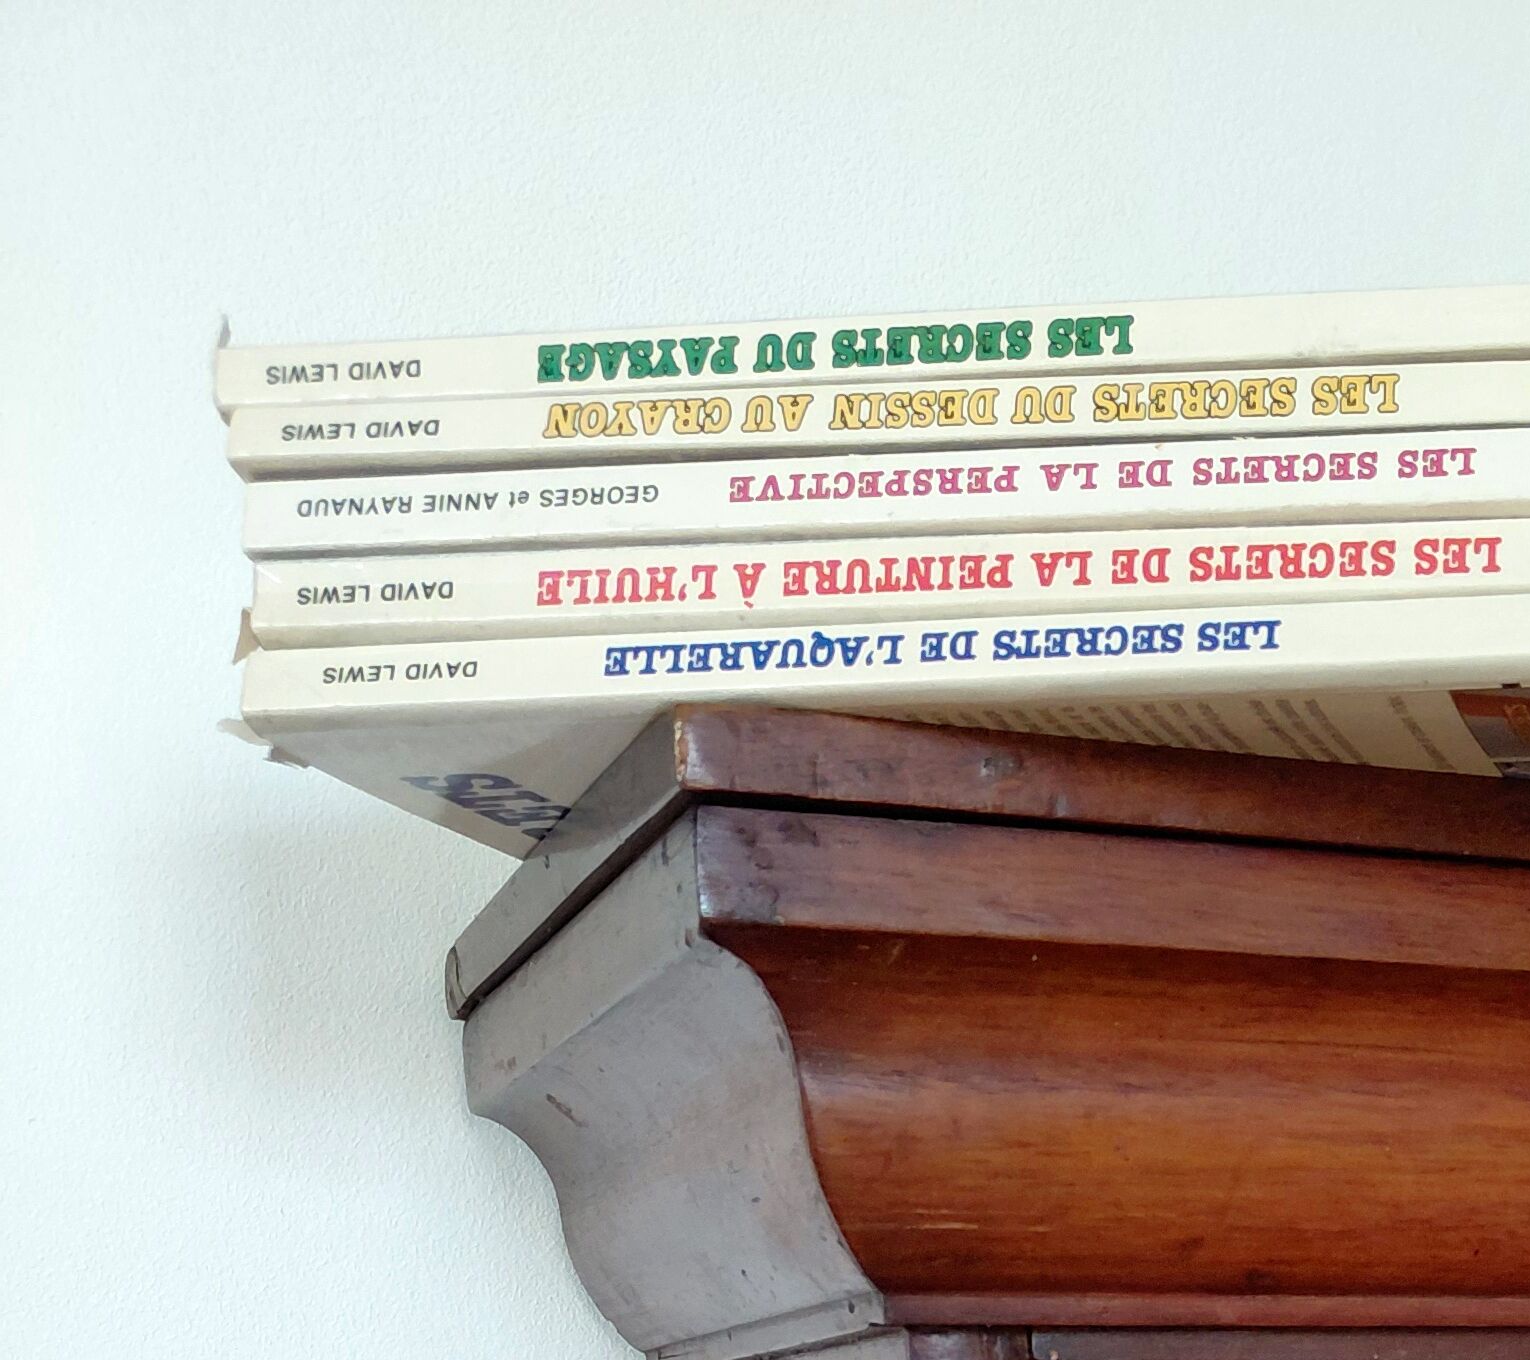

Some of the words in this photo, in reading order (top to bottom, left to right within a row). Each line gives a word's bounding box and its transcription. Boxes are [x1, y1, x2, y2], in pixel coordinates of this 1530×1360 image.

[753, 332, 817, 372] DU
[831, 318, 1032, 368] SECRETS
[1048, 315, 1134, 357] LES
[266, 363, 341, 385] LEWIS
[348, 359, 421, 382] DAVID
[537, 337, 740, 383] PAYSAGE
[829, 388, 999, 430] DESSIN
[1010, 385, 1076, 424] DU
[1092, 377, 1298, 422] SECRETS
[1311, 373, 1400, 415] LES
[281, 421, 358, 441] LEWIS
[366, 419, 440, 438] DAVID
[543, 398, 732, 438] CRAYON
[742, 394, 812, 433] AU
[1041, 462, 1098, 490] LA
[1118, 459, 1173, 488] DE
[1193, 451, 1378, 485] SECRETS
[1397, 447, 1476, 478] LES
[421, 490, 499, 512] ANNIE
[508, 489, 530, 509] et
[540, 484, 658, 507] GEORGES
[728, 465, 1020, 502] PERSPECTIVE
[297, 495, 412, 517] RAYNAUD
[783, 553, 1012, 595] PEINTURE
[1032, 550, 1092, 586] LA
[1111, 547, 1170, 584] DE
[1189, 539, 1396, 580] SECRETS
[1413, 537, 1502, 575] LES
[297, 583, 370, 605] LEWIS
[380, 580, 454, 601] DAVID
[536, 564, 717, 605] L'HUILE
[736, 562, 765, 607] À
[603, 631, 903, 676] L'AQUARELLE
[920, 630, 979, 663] DE
[992, 623, 1183, 661] SECRETS
[1197, 619, 1281, 652] LES
[322, 663, 395, 684] LEWIS
[406, 661, 478, 679] DAVID
